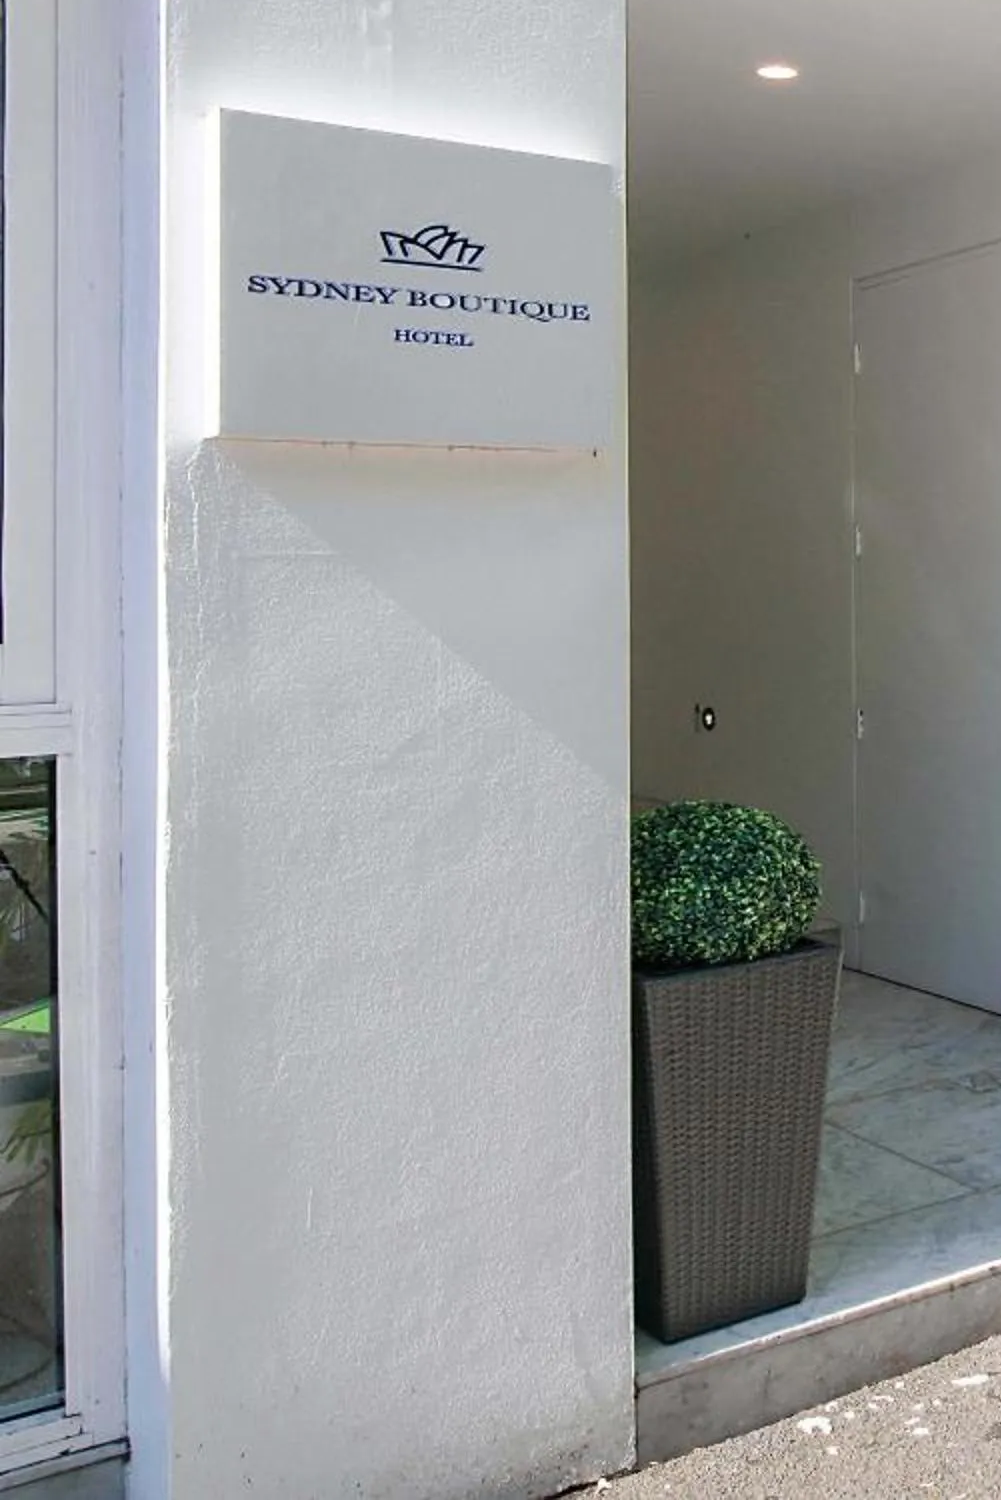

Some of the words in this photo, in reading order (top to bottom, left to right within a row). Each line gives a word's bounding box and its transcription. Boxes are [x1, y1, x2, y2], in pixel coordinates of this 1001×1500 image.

[247, 274, 398, 305] SYDNEY
[405, 289, 591, 323] BOUTIQUE
[393, 328, 475, 348] HOTEL
